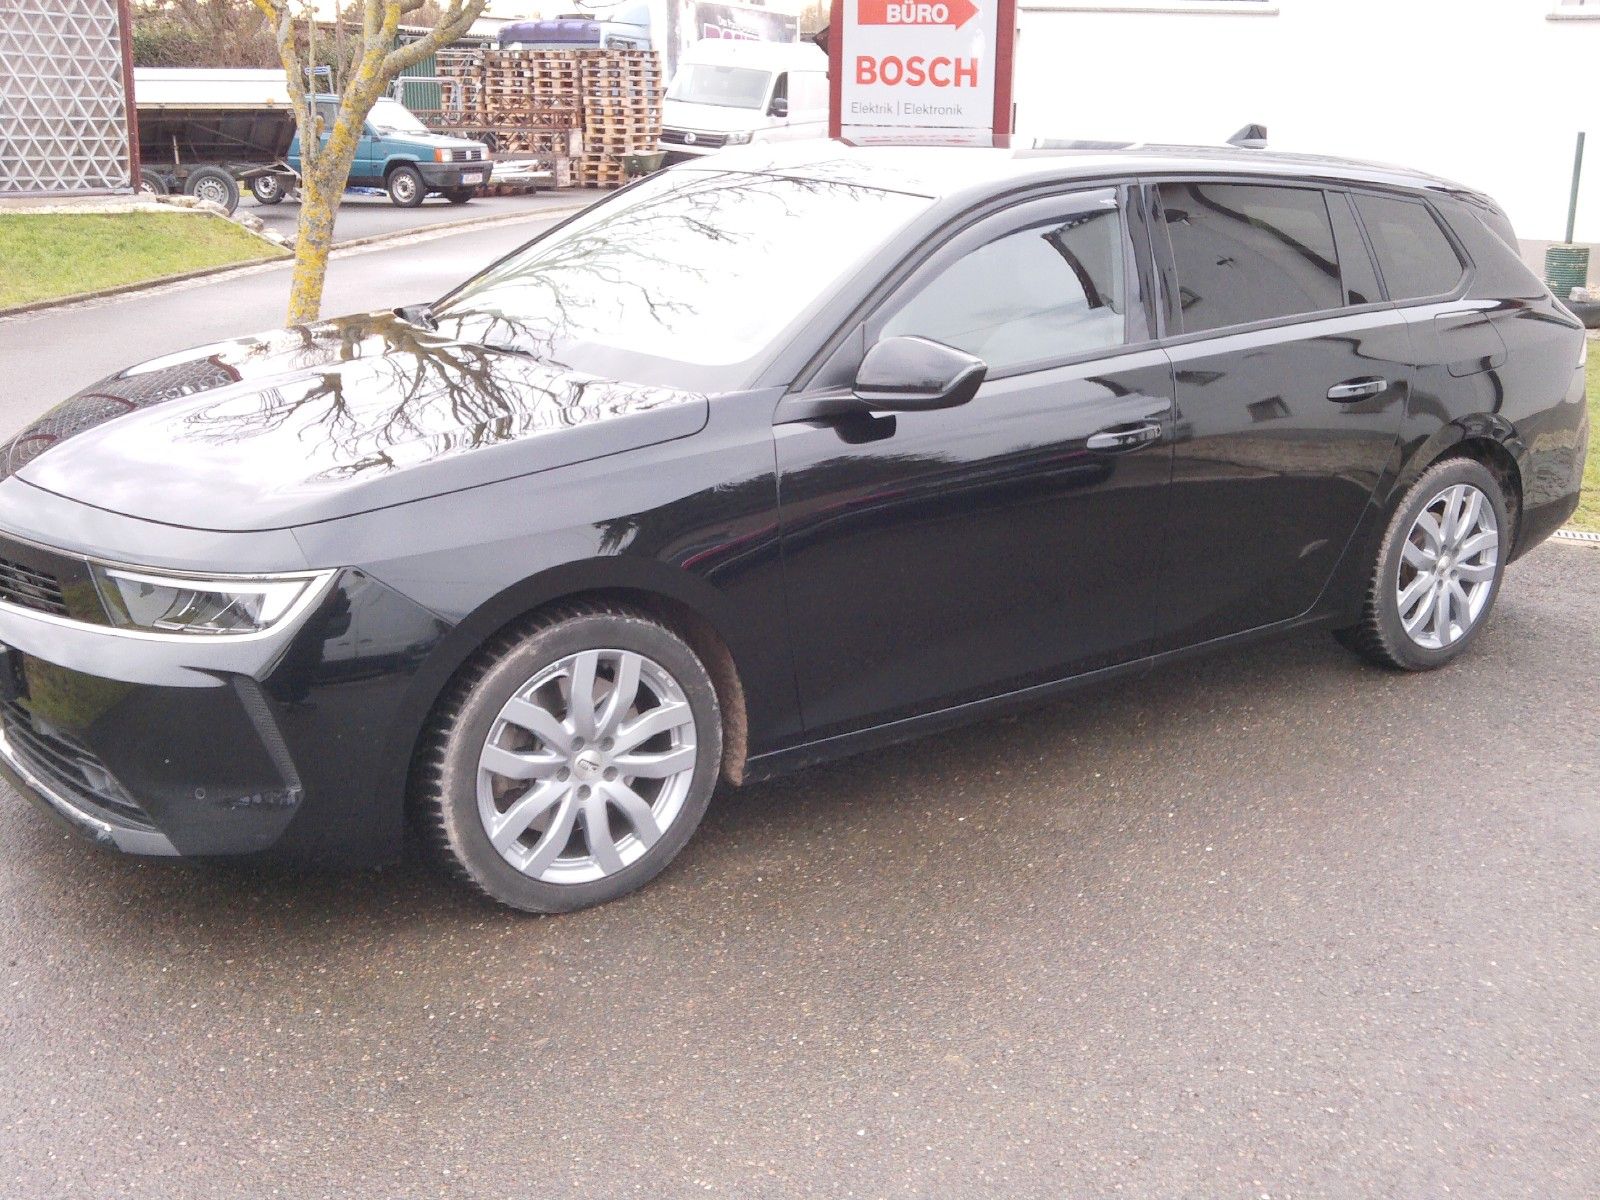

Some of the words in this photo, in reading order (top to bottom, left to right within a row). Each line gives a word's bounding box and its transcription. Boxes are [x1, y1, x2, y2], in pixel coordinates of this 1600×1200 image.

[886, 0, 949, 24] BÜRO
[856, 55, 978, 88] BOSCH
[851, 101, 893, 114] Elektrik
[904, 102, 963, 116] Elektronik
